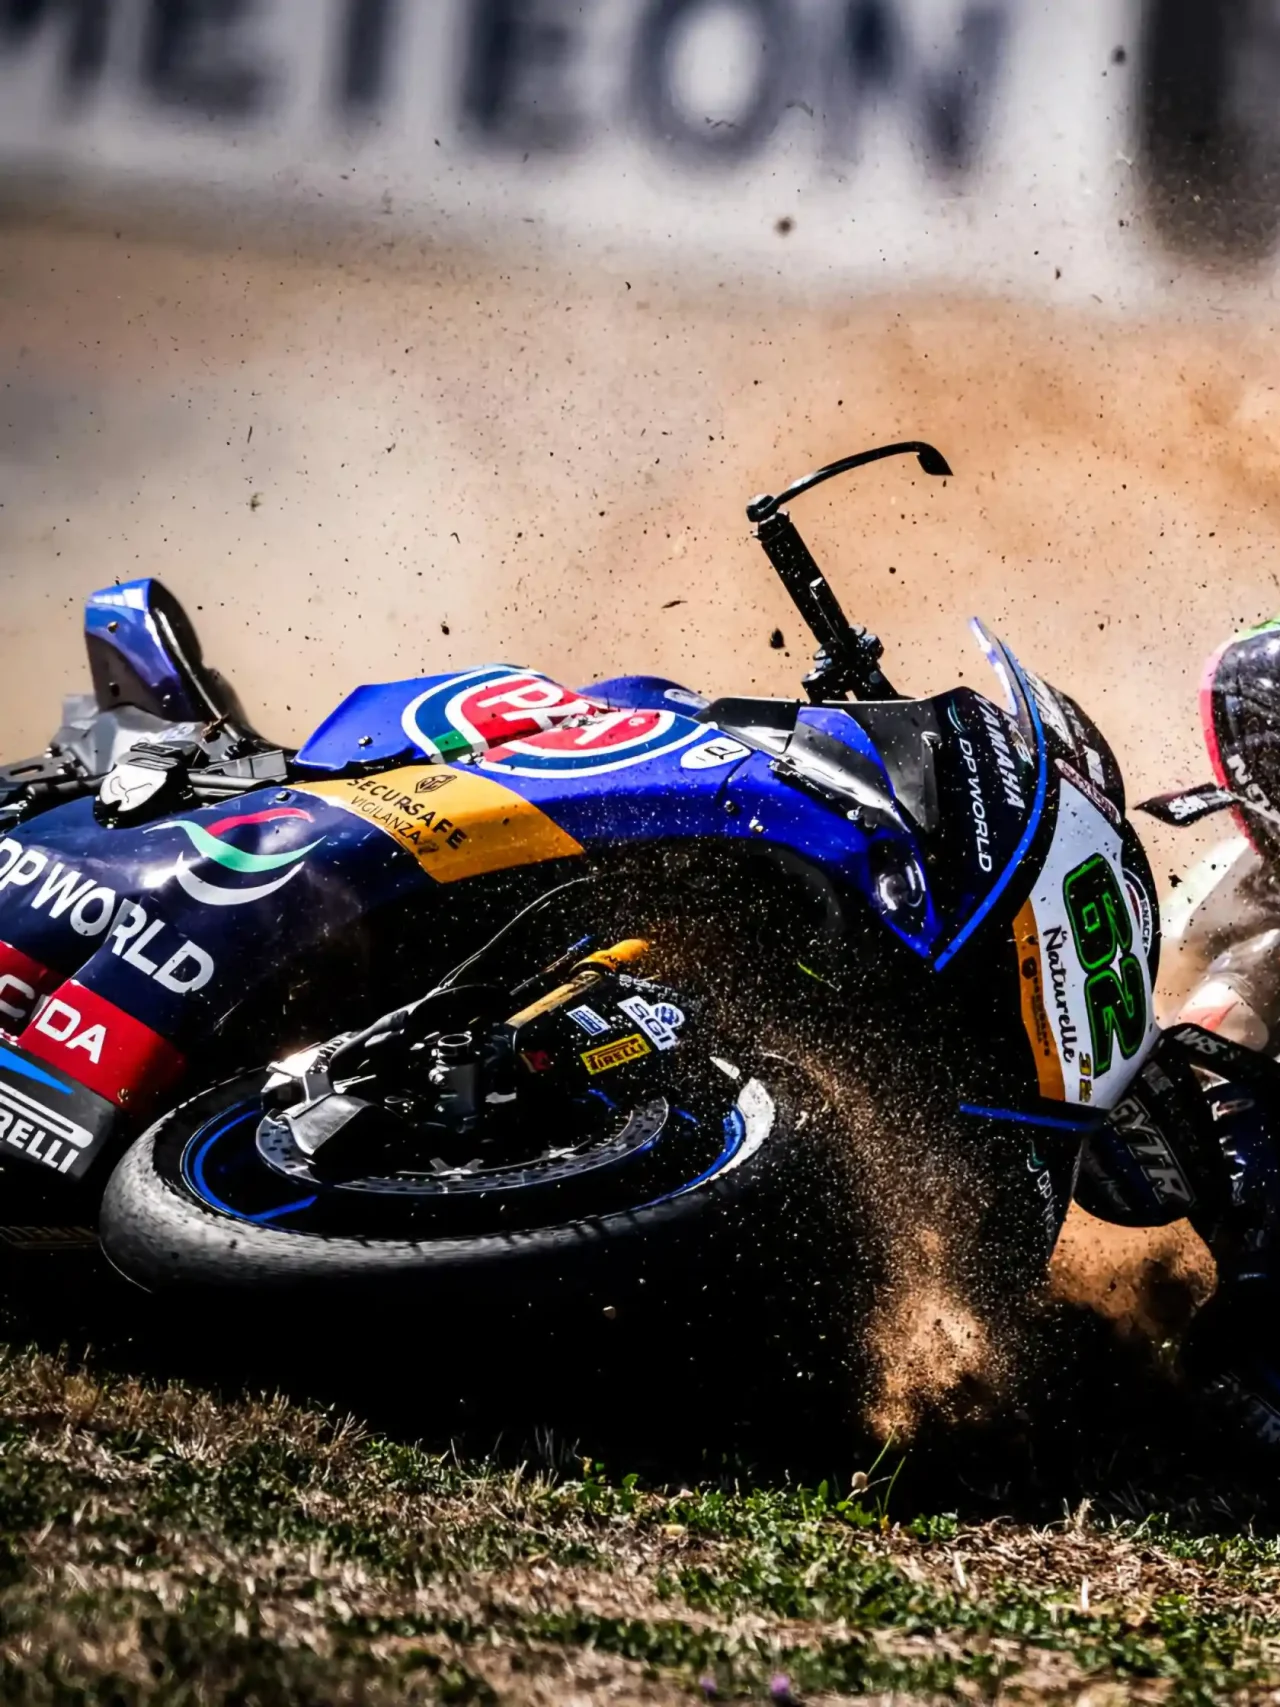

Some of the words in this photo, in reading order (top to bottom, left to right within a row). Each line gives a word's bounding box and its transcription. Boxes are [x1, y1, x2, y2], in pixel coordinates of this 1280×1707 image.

[346, 778, 468, 850] SECURSAFE
[350, 796, 423, 845] VIGILANZA
[1062, 852, 1147, 1080] 62
